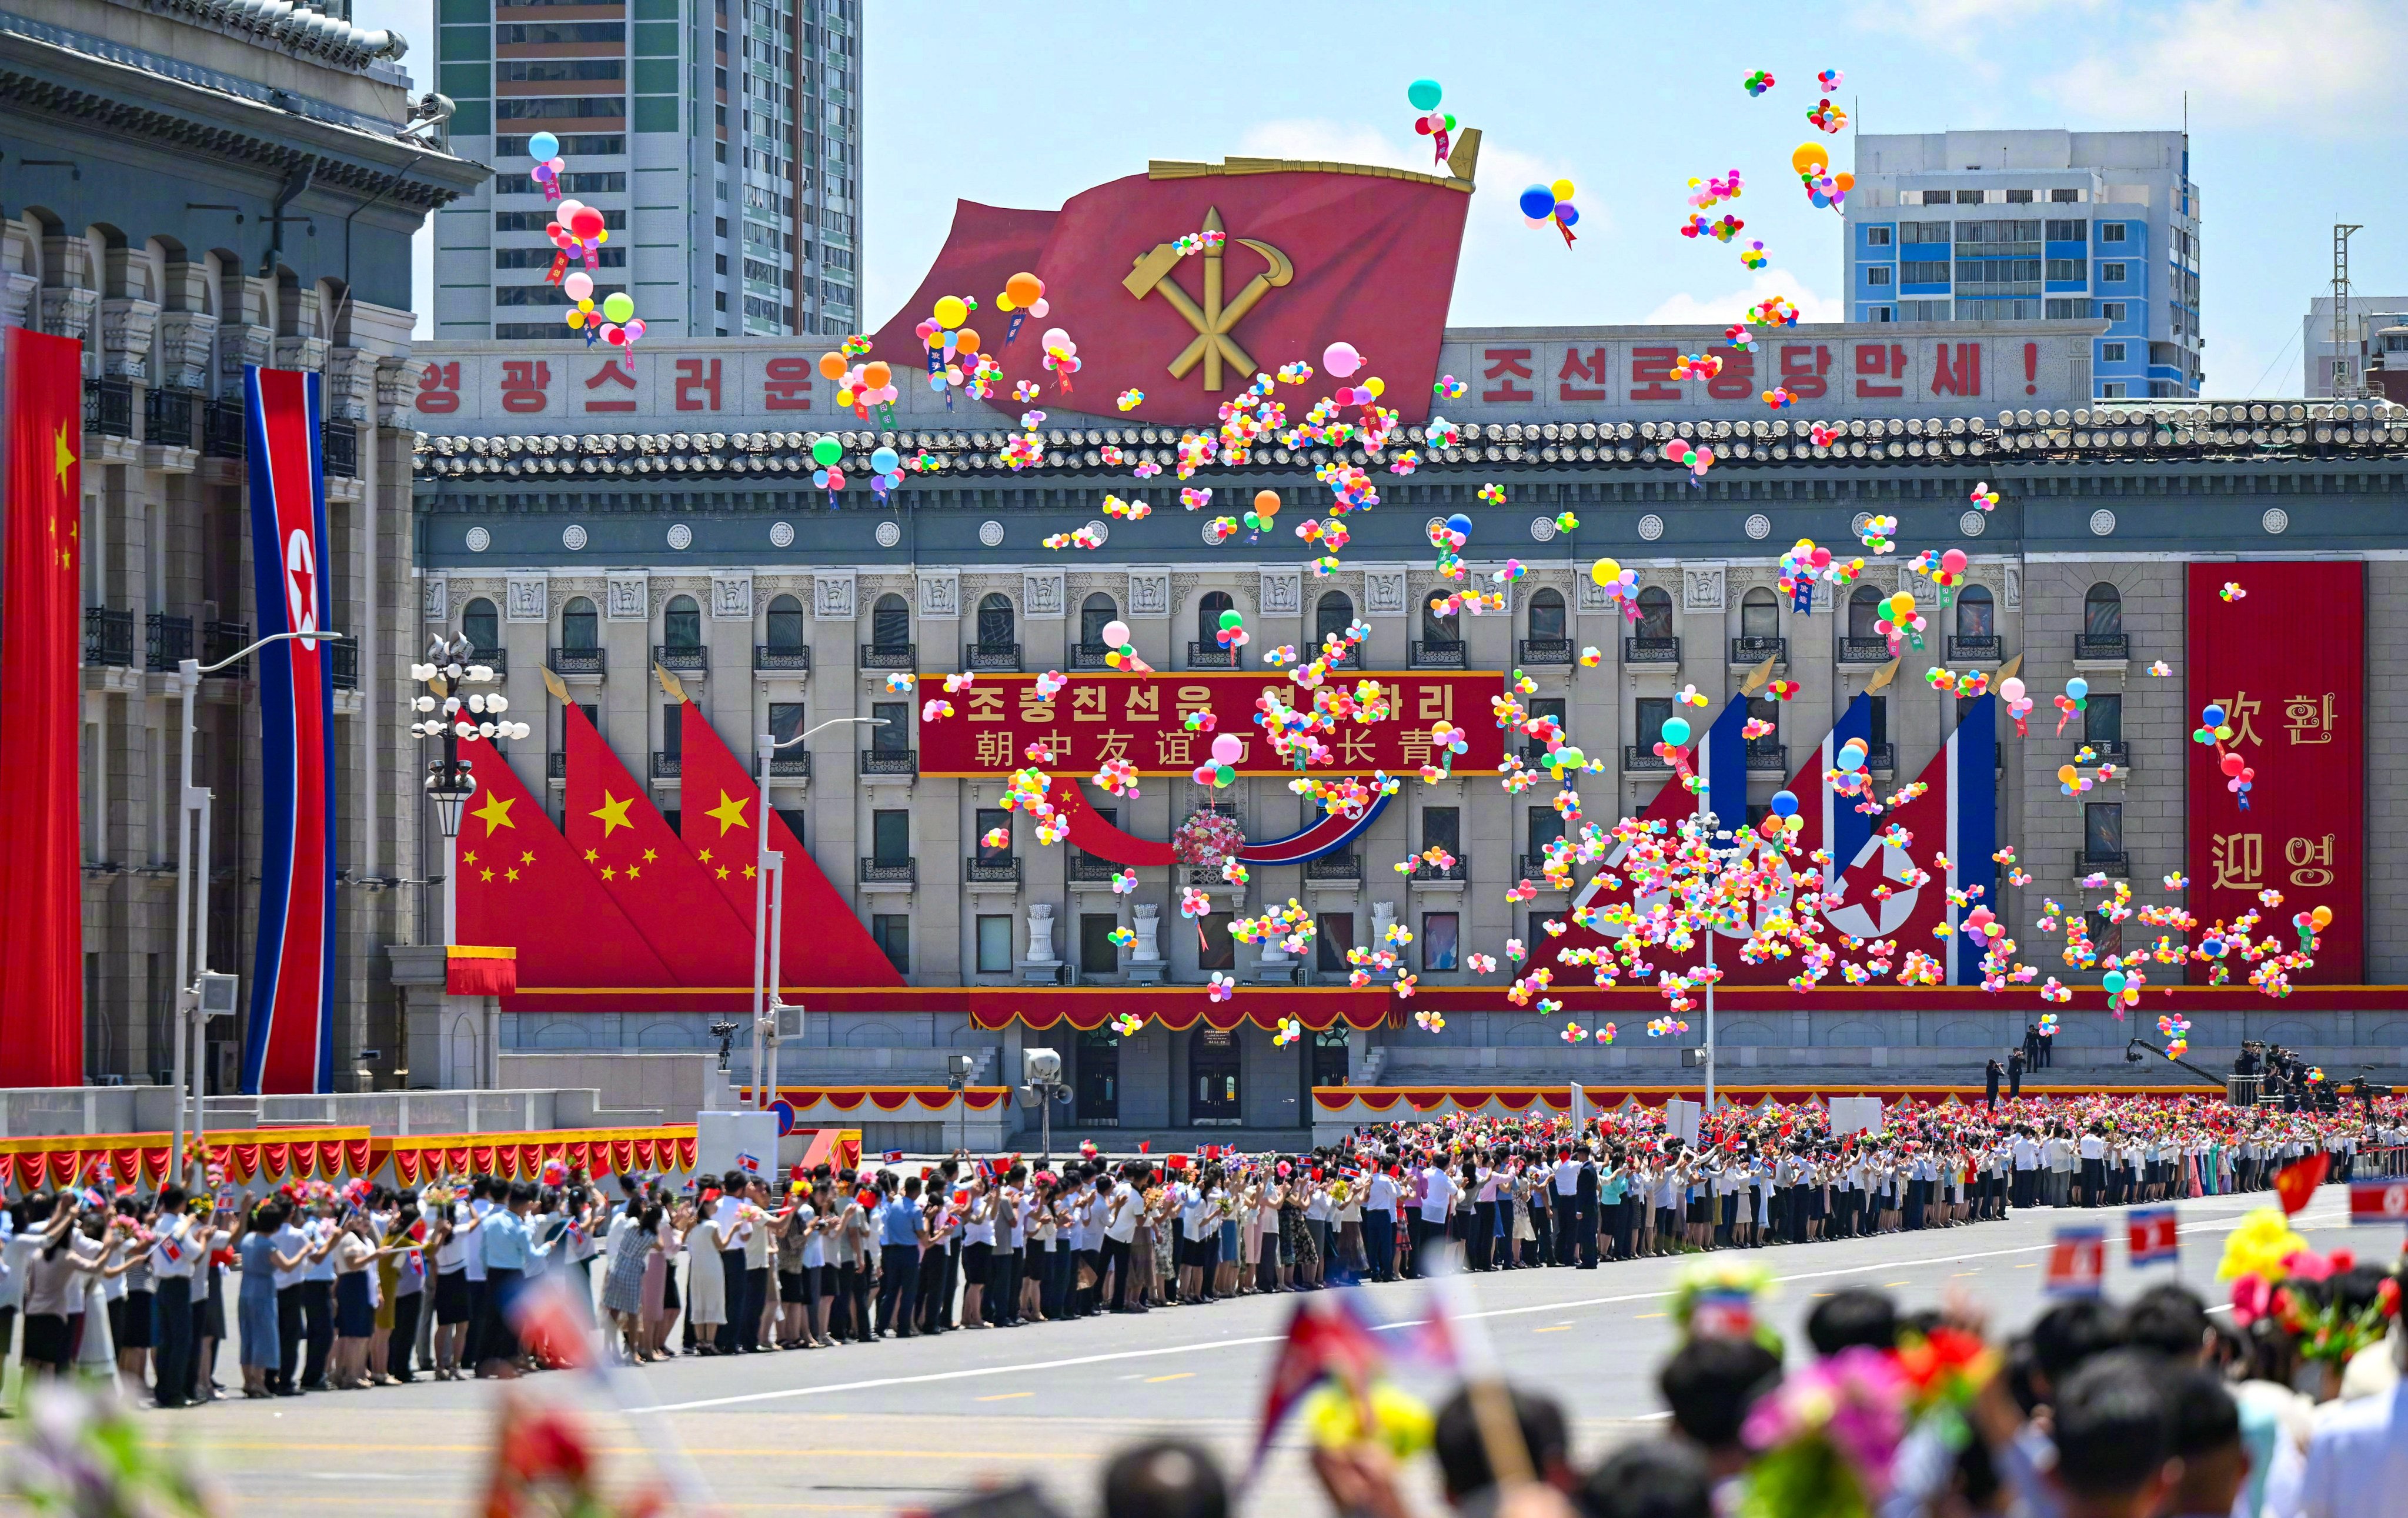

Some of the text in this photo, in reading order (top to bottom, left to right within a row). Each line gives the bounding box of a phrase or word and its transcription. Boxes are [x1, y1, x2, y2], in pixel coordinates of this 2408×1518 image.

[415, 357, 811, 413] 영광스러운
[880, 403, 891, 423] 환영
[1364, 404, 1377, 425] 欢迎
[1799, 584, 1809, 605] 欢迎
[1942, 588, 1950, 603] 환영
[968, 685, 1212, 723] 조중친선은
[975, 728, 1435, 767] 朝中友谊万长青
[2212, 690, 2263, 890] 欢迎
[2282, 692, 2339, 887] 환영
